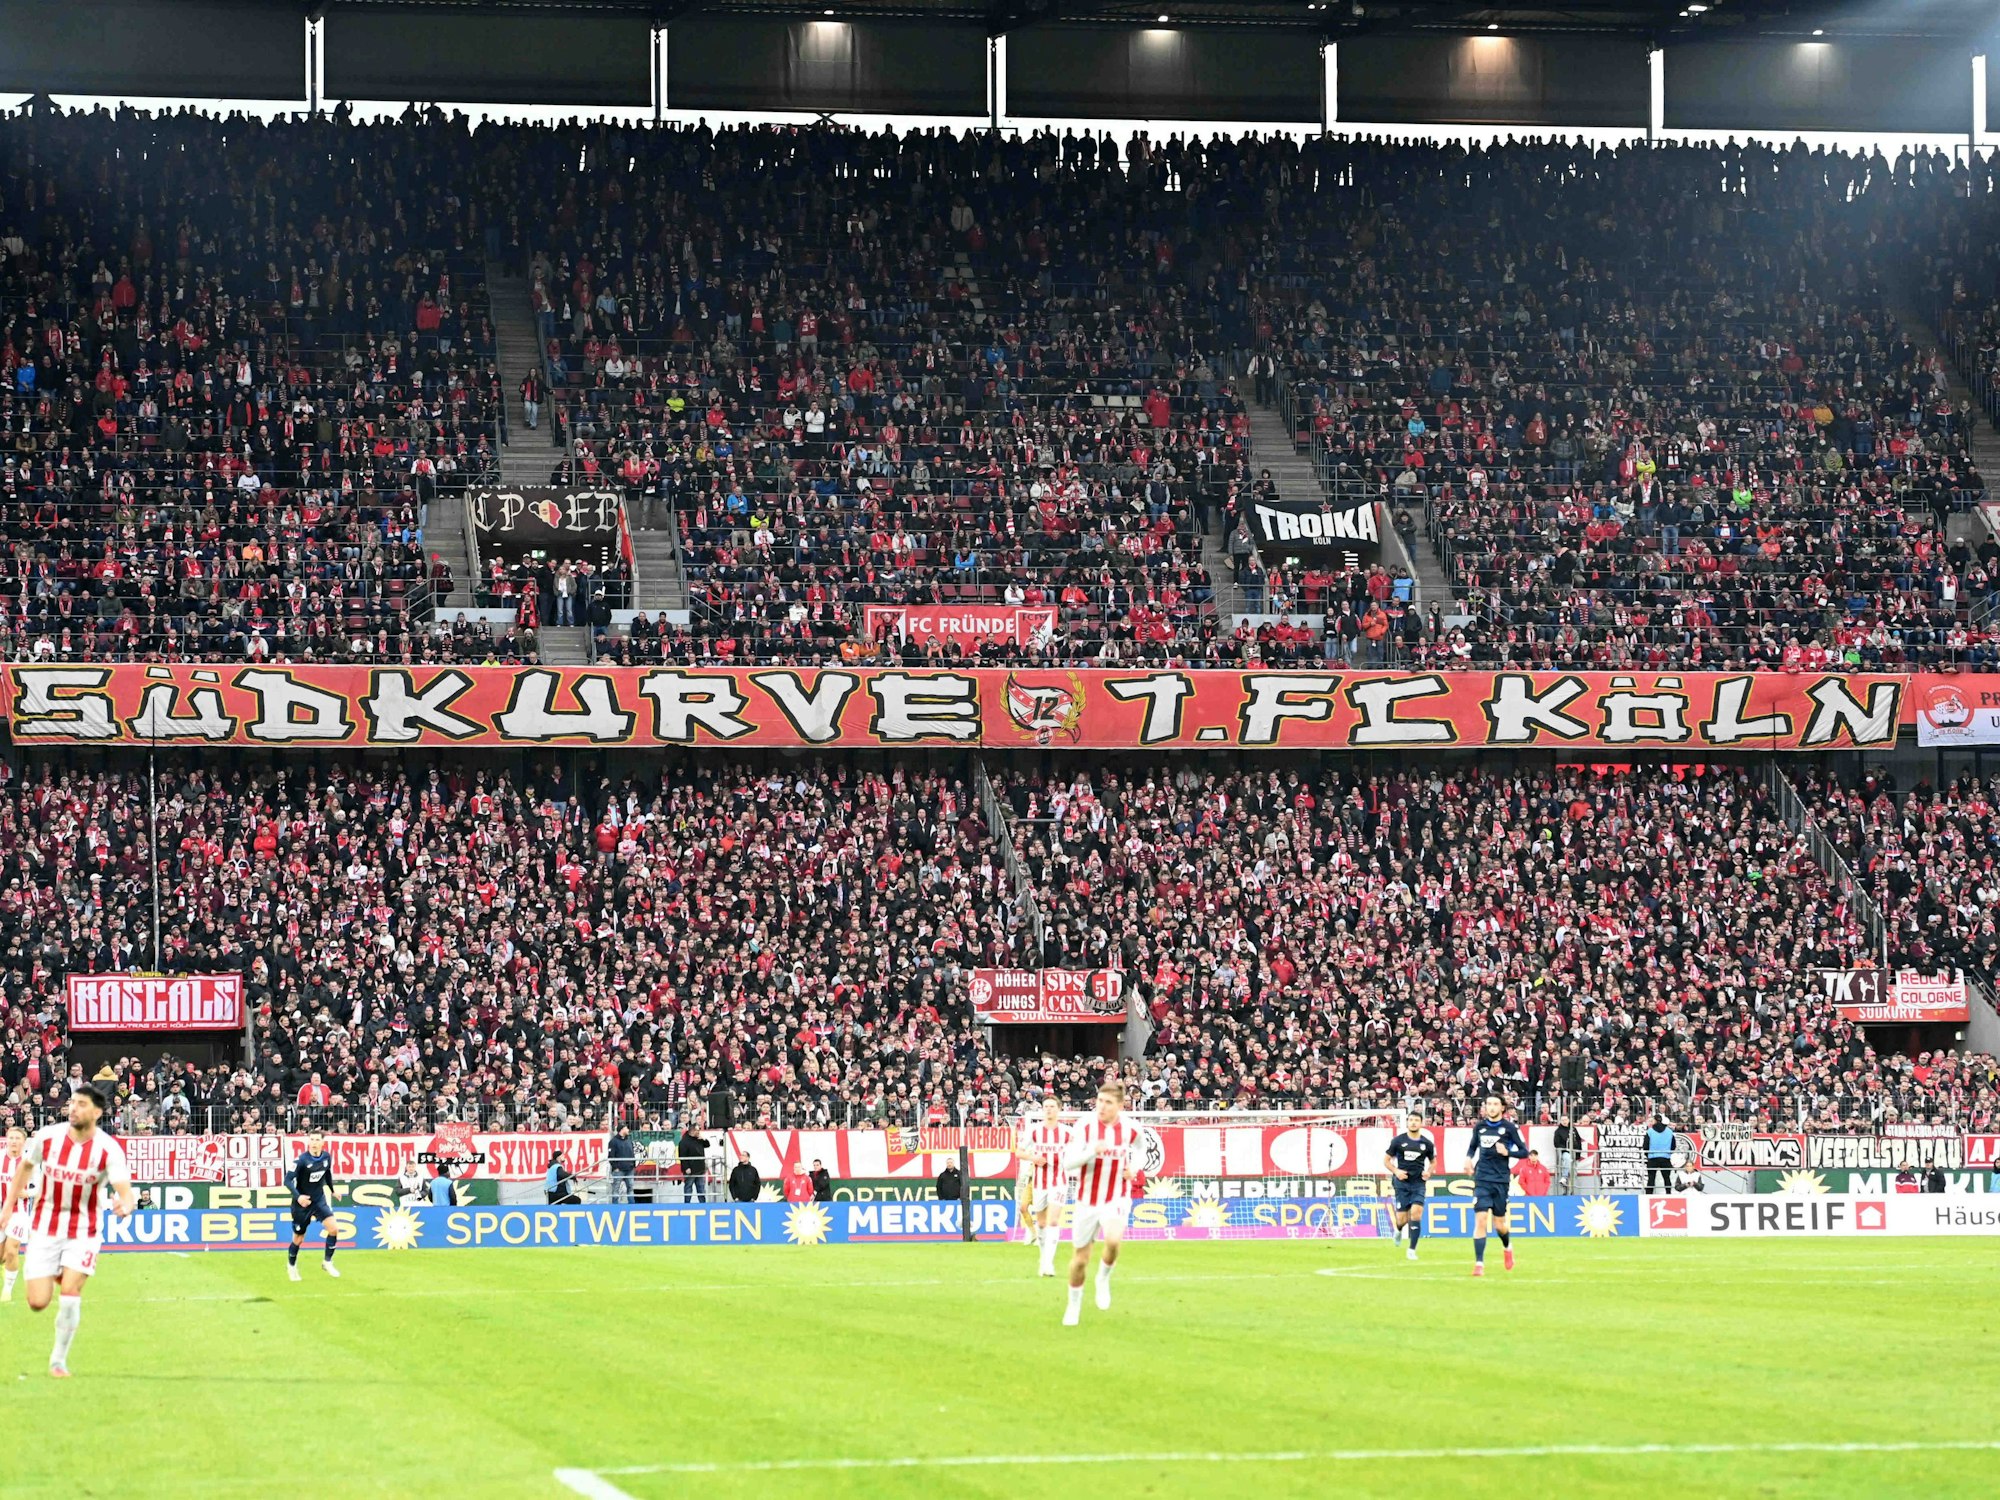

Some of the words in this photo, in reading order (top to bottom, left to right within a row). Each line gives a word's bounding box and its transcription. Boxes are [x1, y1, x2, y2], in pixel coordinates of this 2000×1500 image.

[1254, 502, 1379, 544] TROIKA
[909, 618, 931, 633] FC
[939, 614, 1015, 633] FRÜNDE
[11, 667, 983, 744] SÜDKURVE
[1033, 696, 1058, 720] 12
[1480, 673, 1901, 745] KÖLN
[995, 970, 1036, 987] HÖHER
[1046, 973, 1085, 991] SPS
[1823, 972, 1856, 1001] TK
[75, 981, 235, 1022] RASCALS
[997, 995, 1036, 1010] JUNGS
[1048, 995, 1086, 1012] CGN
[1901, 991, 1961, 1004] COLOGNE
[1720, 1131, 1736, 1140] CON
[126, 1140, 198, 1159] SEMPER
[261, 1137, 279, 1158] 2
[45, 1166, 83, 1184] REWE
[230, 1170, 248, 1187] 2
[848, 1204, 1009, 1234] MERKUR
[1710, 1202, 1845, 1231] STREIF
[1936, 1205, 2000, 1225] Häus
[446, 1209, 762, 1244] SPORTWETTEN
